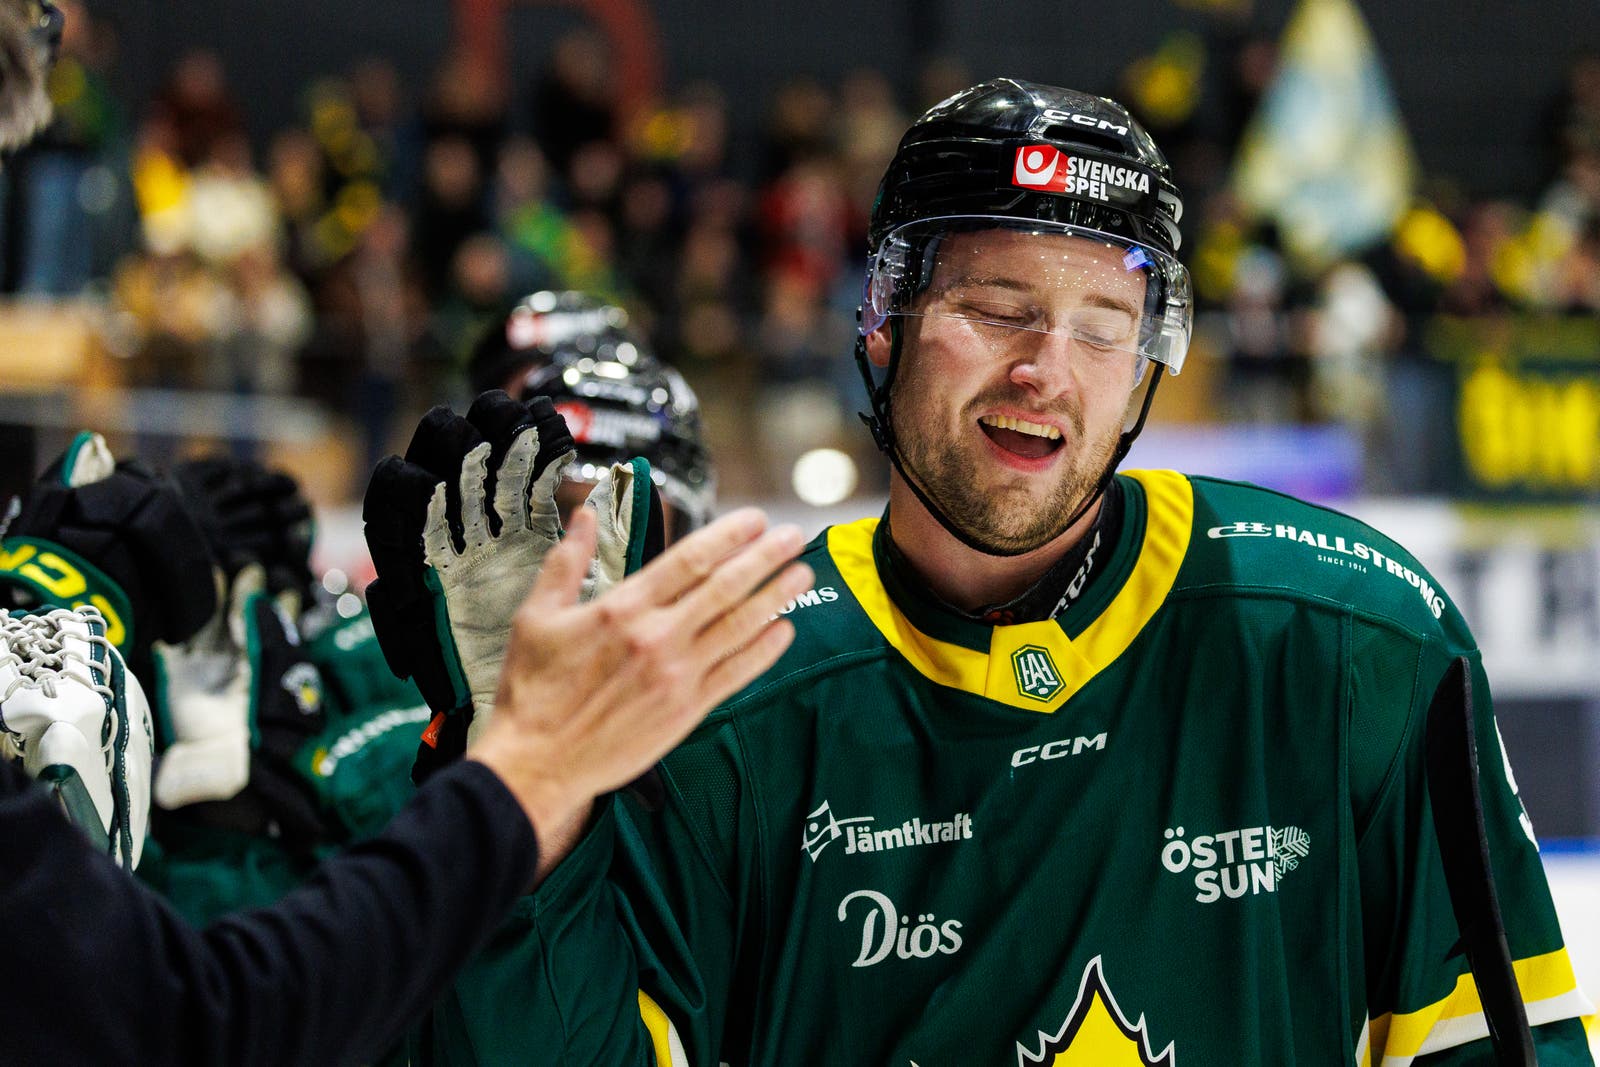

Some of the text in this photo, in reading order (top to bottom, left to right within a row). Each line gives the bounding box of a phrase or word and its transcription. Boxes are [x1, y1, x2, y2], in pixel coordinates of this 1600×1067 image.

[1042, 108, 1129, 136] CCM
[1064, 178, 1110, 203] SPEL
[1067, 156, 1150, 195] SVENSKA
[1317, 554, 1344, 567] SINCE
[1009, 731, 1108, 769] CCM
[845, 812, 973, 855] Jämtkraft
[837, 889, 964, 968] Diös
